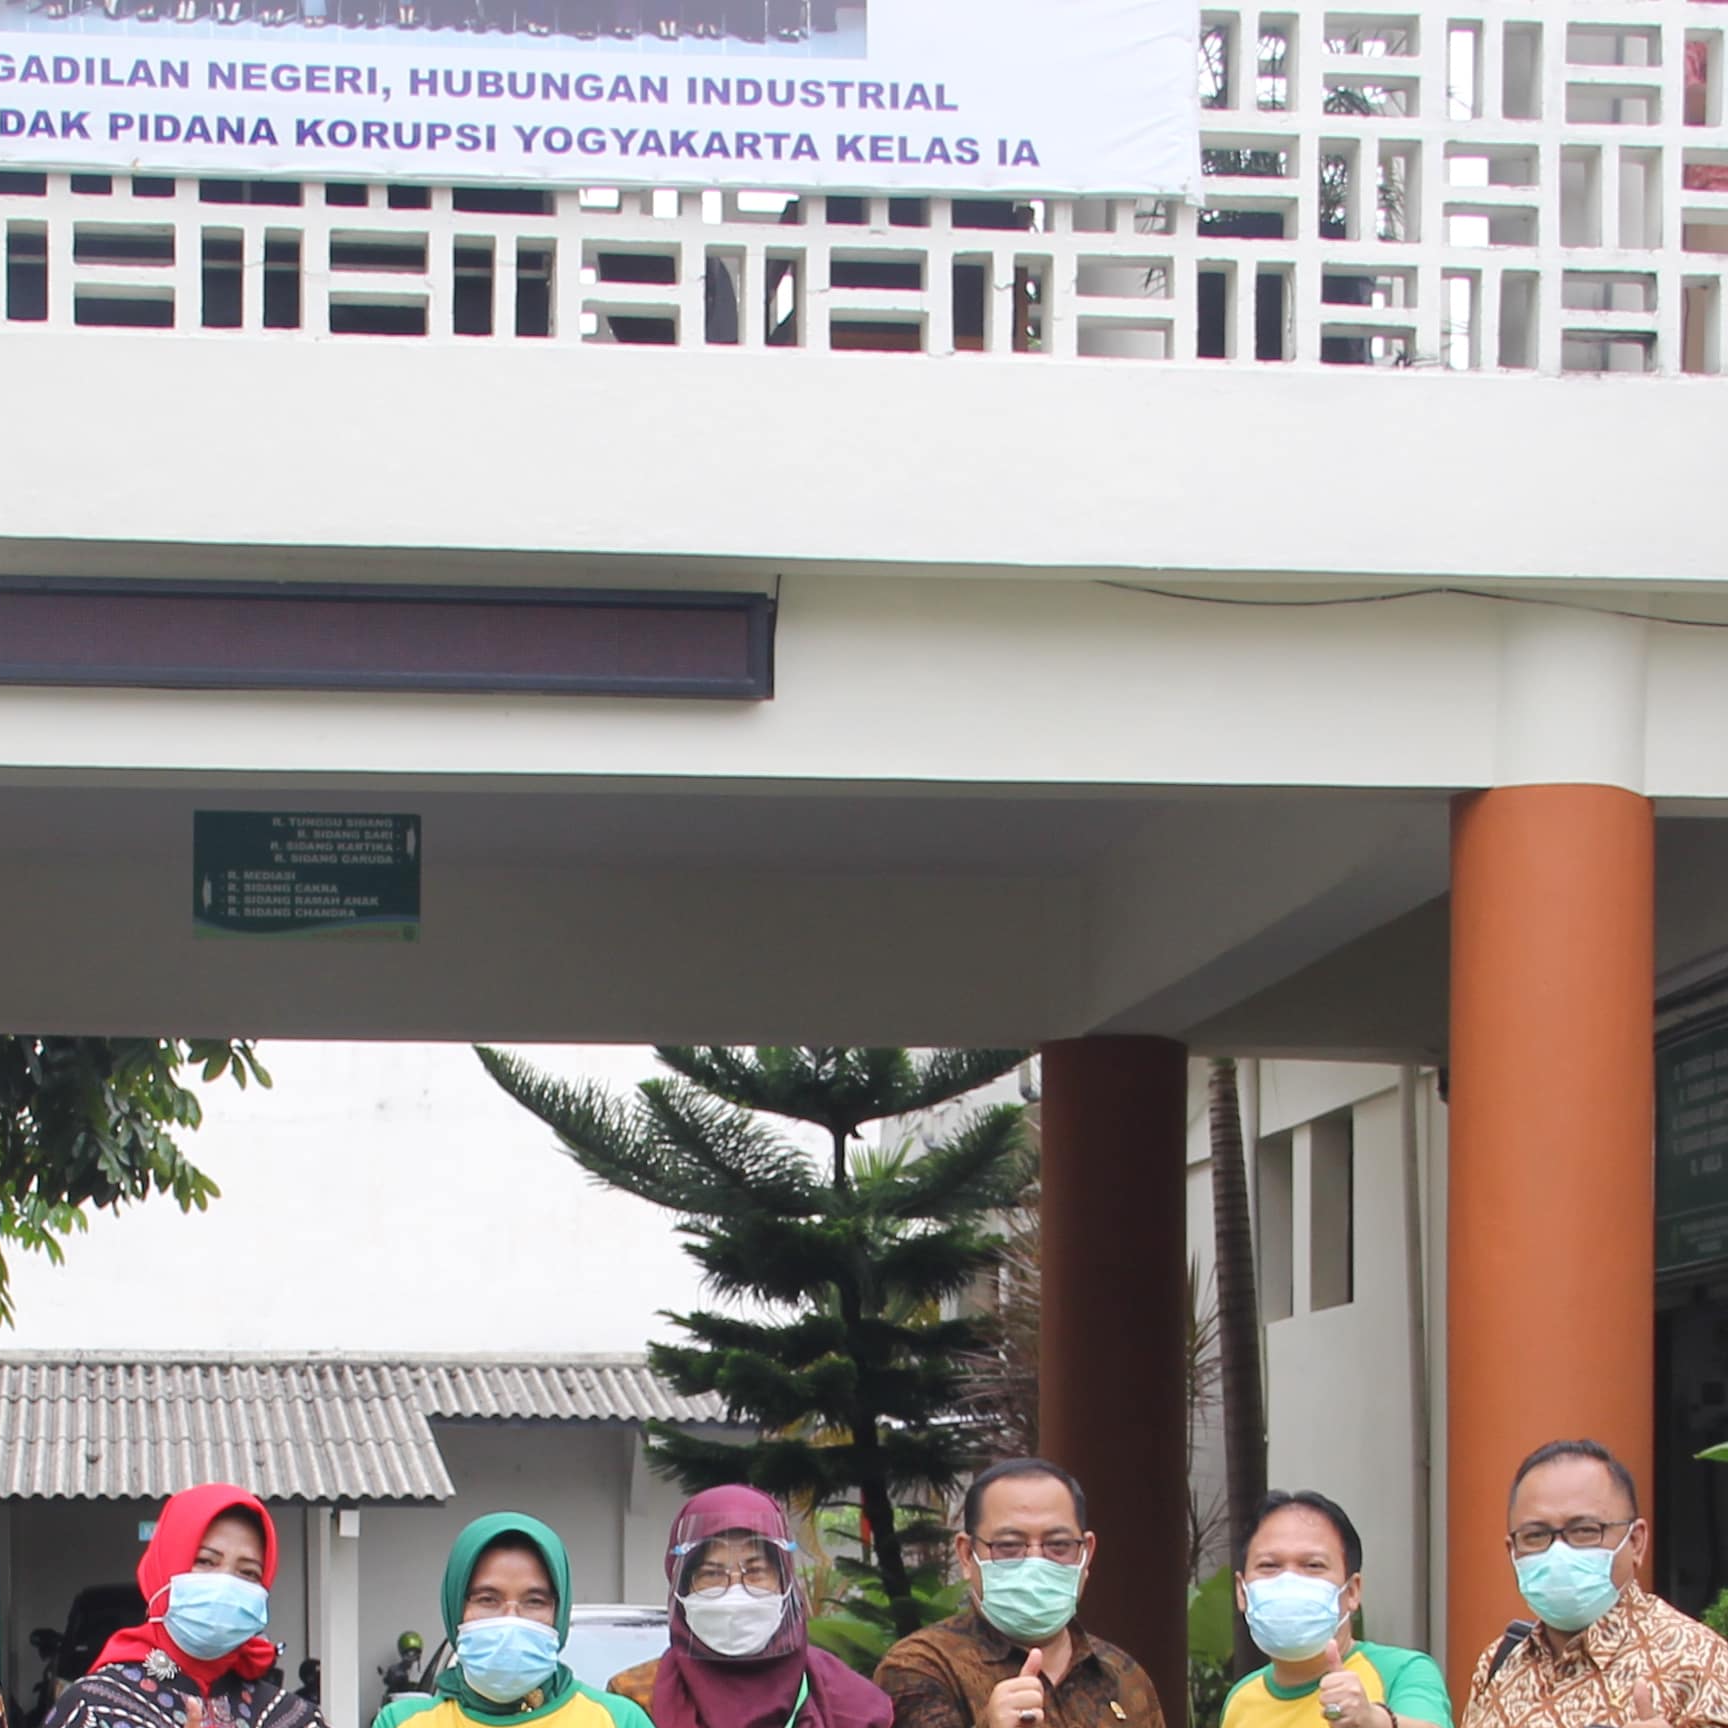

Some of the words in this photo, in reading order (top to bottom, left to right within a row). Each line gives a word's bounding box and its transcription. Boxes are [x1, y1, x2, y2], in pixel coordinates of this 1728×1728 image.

[208, 63, 392, 102] NEGERI,
[410, 69, 669, 103] HUBUNGAN
[688, 79, 958, 111] INDUSTRIAL
[109, 114, 278, 145] PIDANA
[296, 120, 497, 152] KORUPSI
[515, 127, 819, 161] YOGYAKARTA
[837, 135, 980, 165] KELAS
[999, 139, 1039, 167] IA
[345, 818, 393, 829] SIDANG
[313, 830, 360, 841] SIDANG
[364, 830, 393, 841] SARI
[286, 841, 334, 852] SIDANG
[290, 853, 338, 864] SIDANG
[243, 870, 296, 881] MEDIASI
[243, 883, 291, 894] SIDANG
[243, 895, 292, 906] SIDANG
[243, 907, 291, 918] SIDANG
